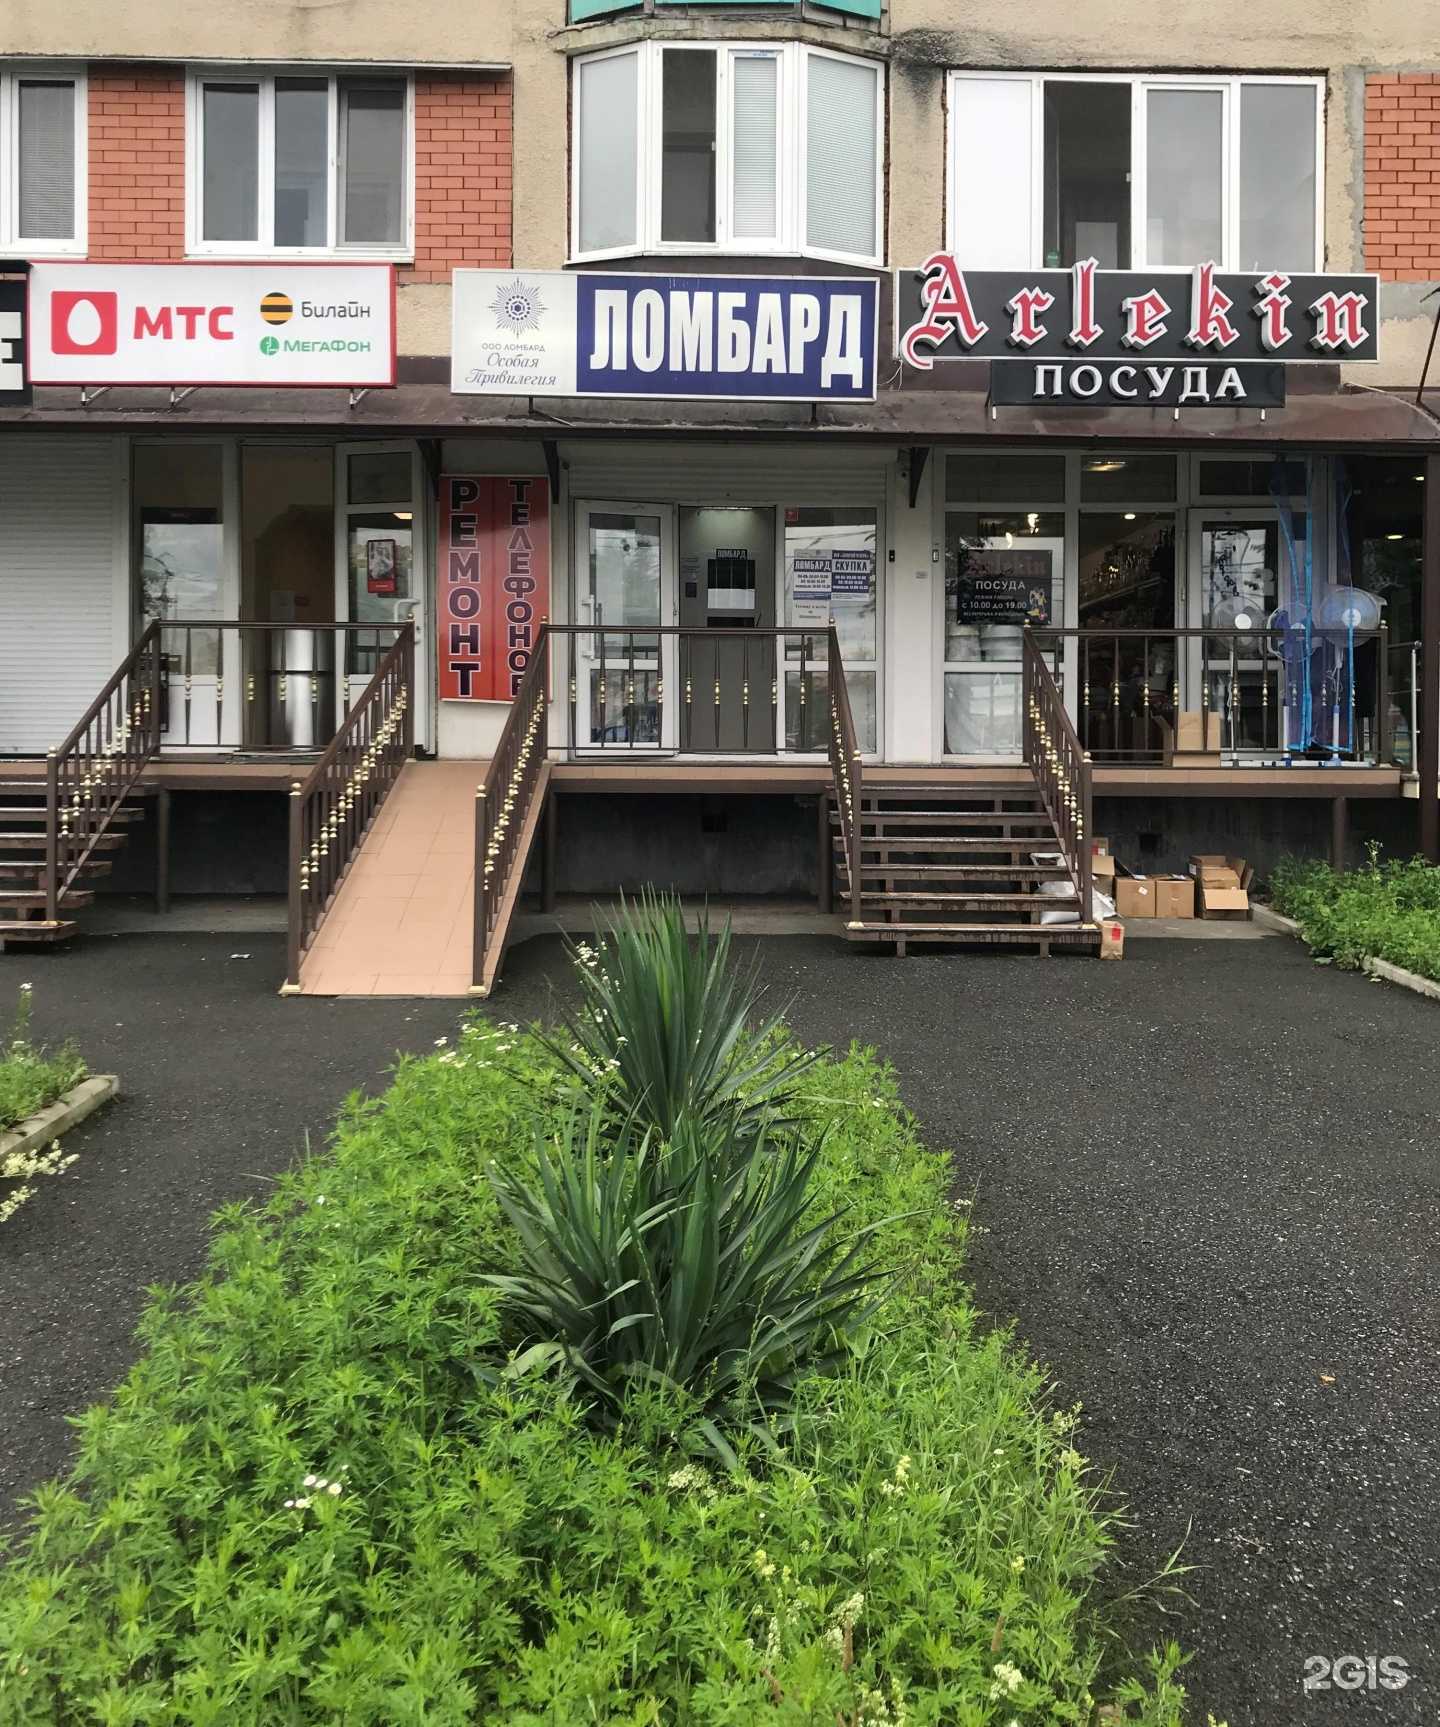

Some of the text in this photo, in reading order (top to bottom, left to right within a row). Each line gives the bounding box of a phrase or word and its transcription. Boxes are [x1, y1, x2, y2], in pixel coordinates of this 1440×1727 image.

[300, 301, 371, 319] Билайн
[900, 250, 1369, 370] Arlekin
[133, 306, 234, 340] МТС
[589, 288, 864, 389] ЛОМБАРД
[481, 343, 546, 353] ООО ЛОМБАРД
[487, 352, 540, 369] Особая
[464, 367, 558, 387] Привилегия
[1033, 364, 1247, 403] ПОСУДА
[795, 560, 831, 571] ЛОМБАРД
[835, 560, 868, 571] СКУПКА
[449, 479, 481, 697] РЕМОНТ
[975, 580, 1026, 591] ПОСУДА
[970, 601, 991, 609] 10.00
[1005, 601, 1027, 609] 19.00
